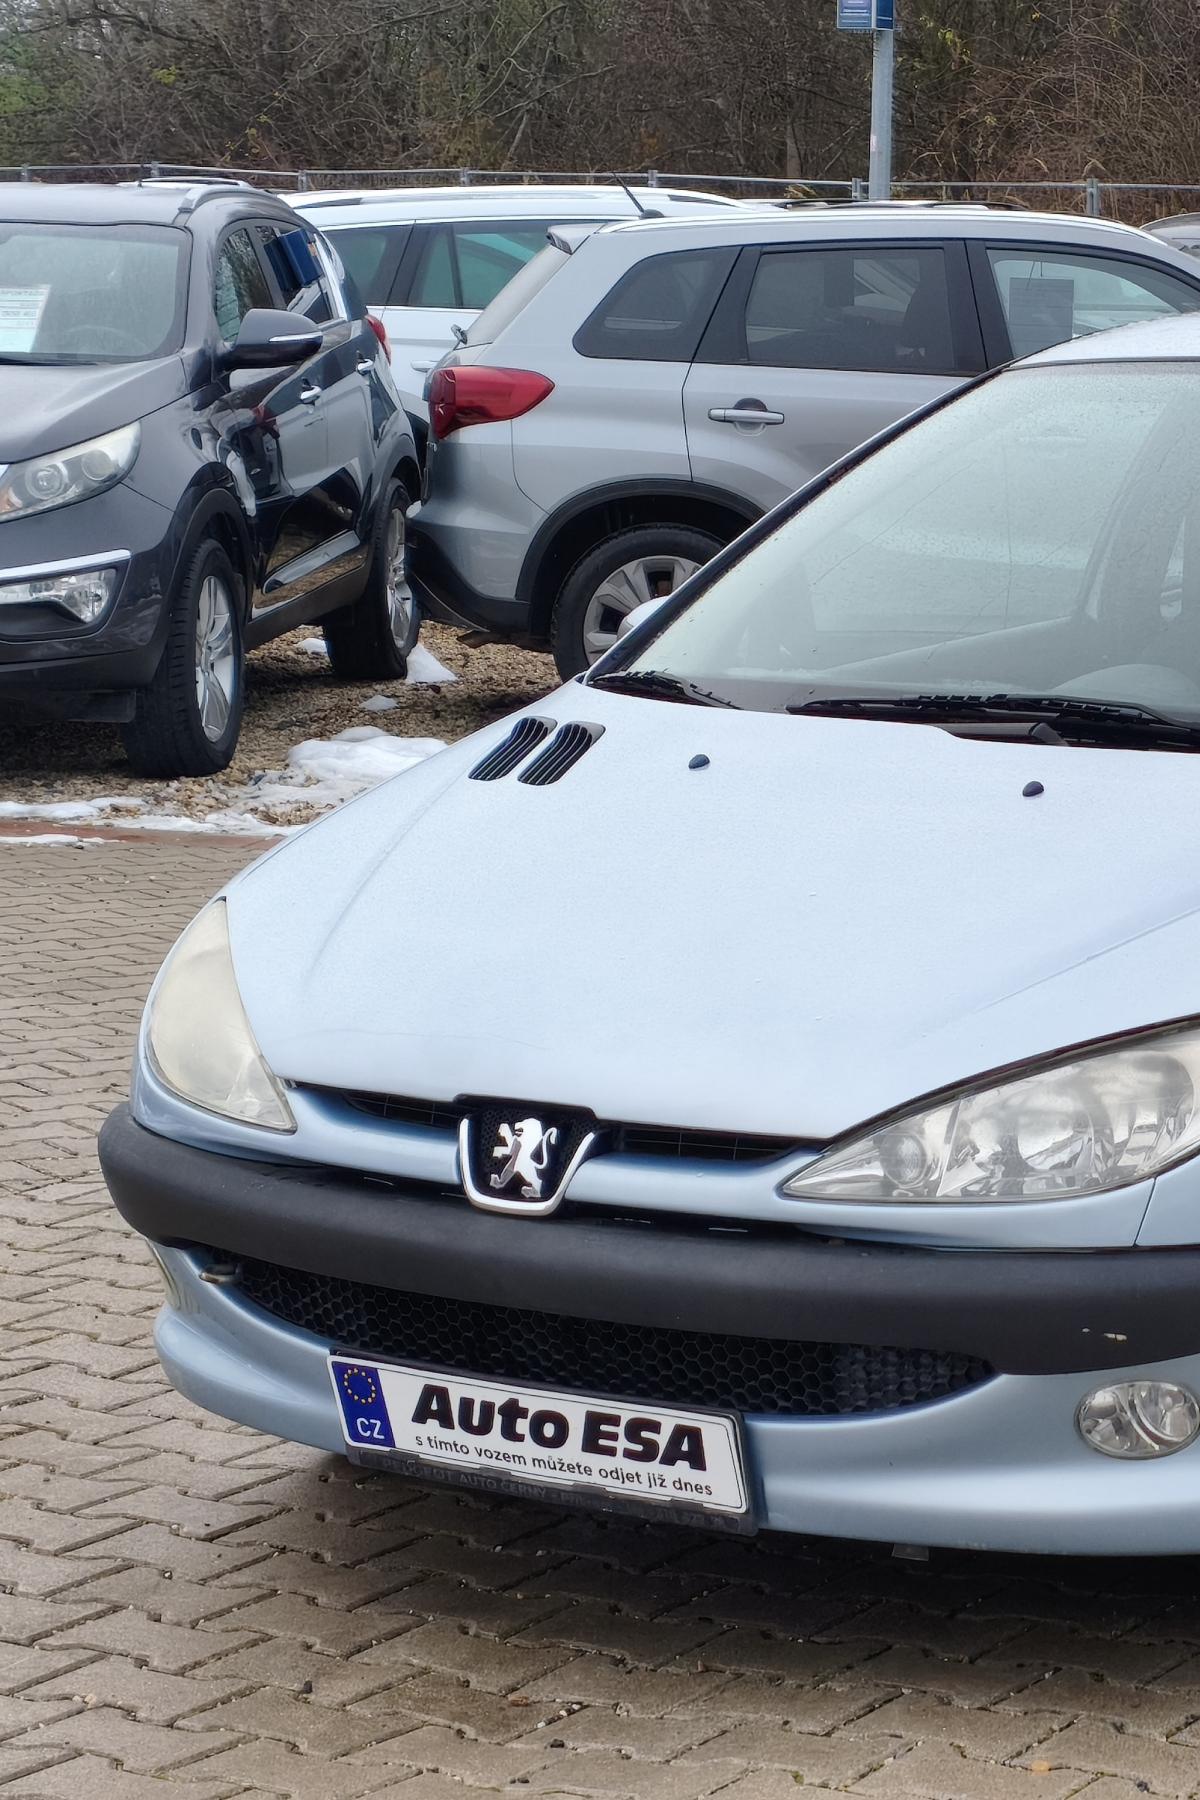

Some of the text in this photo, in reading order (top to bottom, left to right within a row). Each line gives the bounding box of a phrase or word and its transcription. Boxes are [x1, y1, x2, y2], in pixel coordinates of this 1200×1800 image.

[356, 1417, 385, 1440] CZ
[411, 1383, 707, 1472] Auto ESA
[415, 1436, 423, 1446] s
[474, 1446, 528, 1467] vozem
[532, 1455, 593, 1477] můžete
[598, 1467, 643, 1485] odjet
[647, 1472, 668, 1489] již
[672, 1477, 713, 1497] dnes
